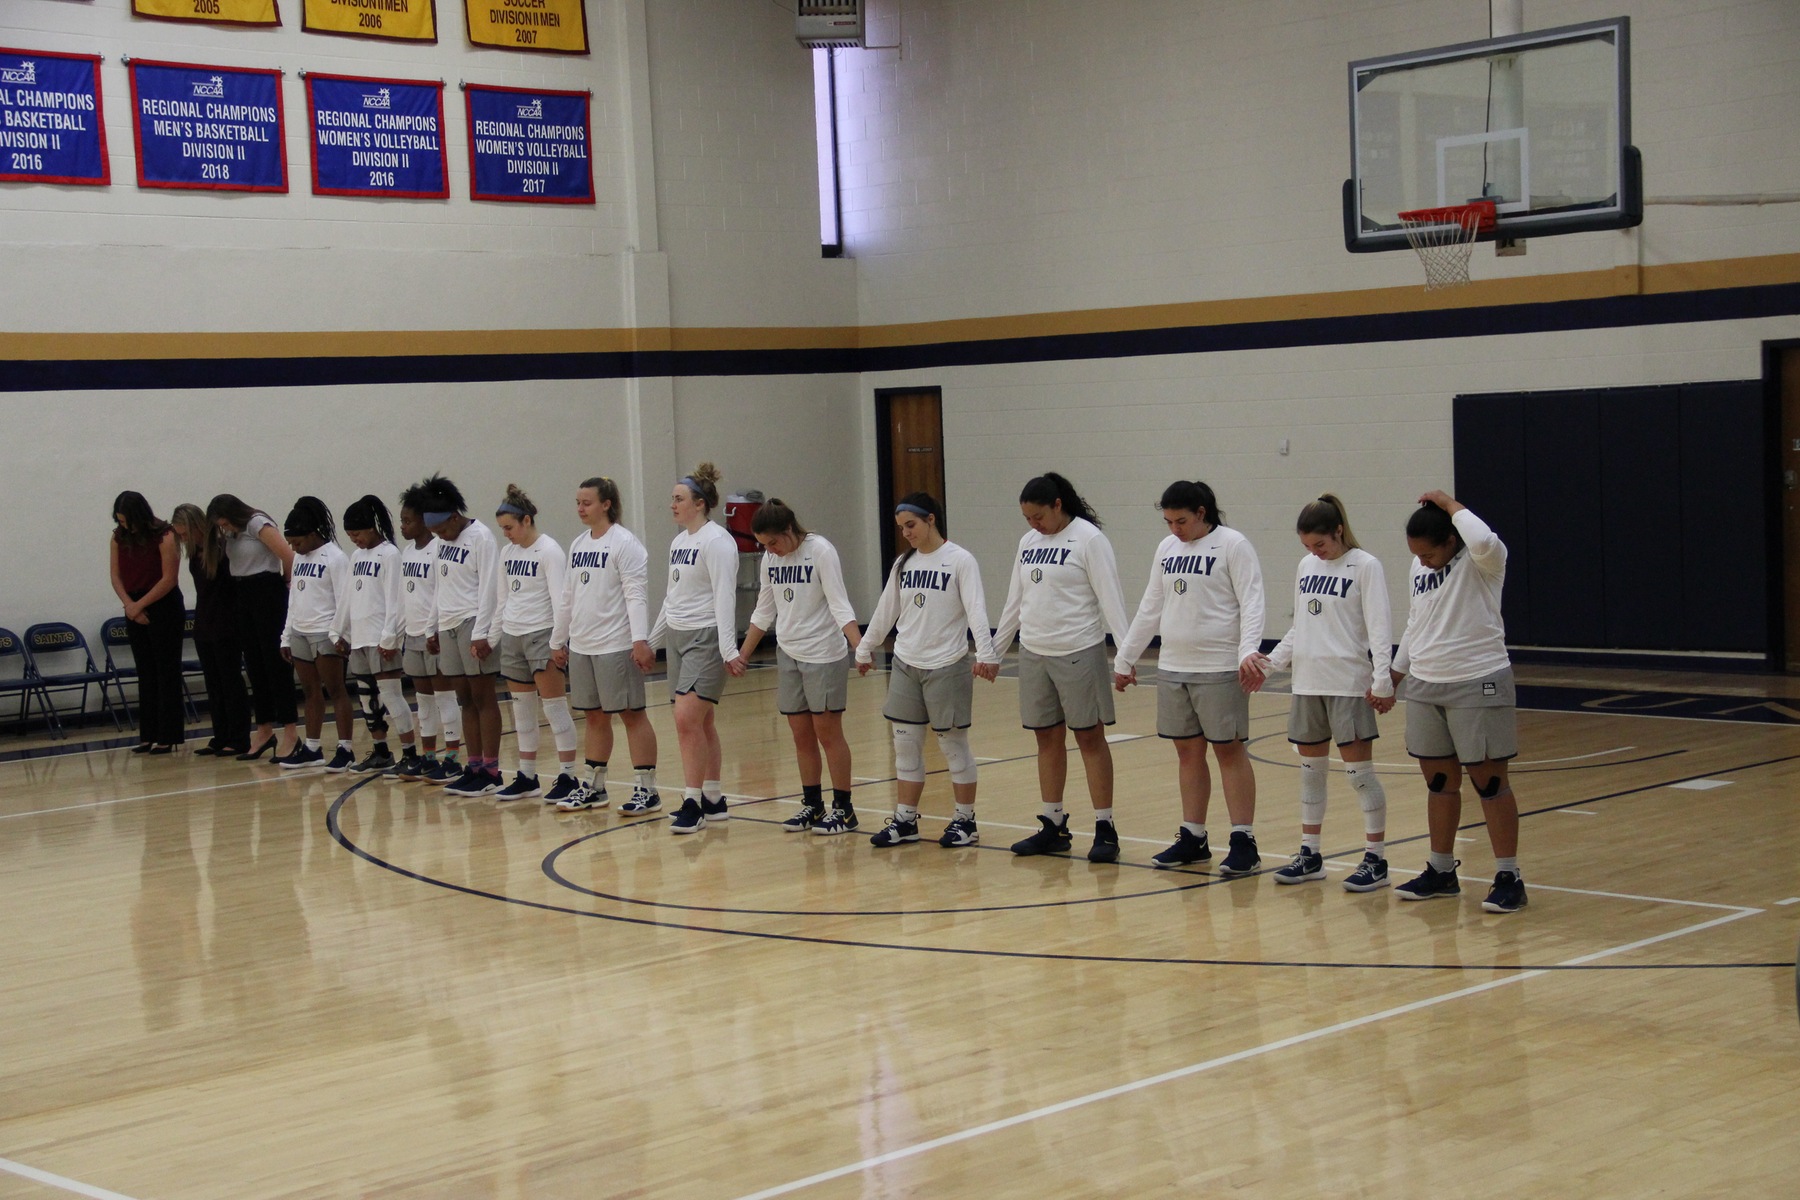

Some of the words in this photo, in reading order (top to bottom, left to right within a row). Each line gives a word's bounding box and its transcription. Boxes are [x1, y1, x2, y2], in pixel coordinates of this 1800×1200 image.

[193, 0, 220, 14] 2005
[331, 0, 378, 9] ISION
[385, 0, 408, 12] MEN
[359, 12, 382, 28] 2006
[489, 9, 532, 25] DIVISION
[533, 12, 539, 26] II
[540, 12, 560, 27] MEN
[515, 28, 537, 44] 2007
[2, 71, 36, 81] NCCAA
[193, 85, 224, 95] NCCAA
[16, 89, 95, 111] CHAMPIONS
[363, 97, 391, 107] NCCAA
[142, 98, 203, 119] REGIONAL
[206, 103, 276, 123] CHAMPIONS
[4, 109, 86, 131] BASKETBALL
[317, 110, 372, 128] REGIONAL
[374, 113, 437, 132] CHAMPIONS
[153, 120, 193, 138] MEN'S
[195, 122, 270, 142] BASKETBALL
[318, 129, 371, 148] WOMEN'S
[373, 132, 439, 150] VOLLEYBALL
[475, 120, 526, 138] REGIONAL
[527, 123, 584, 141] CHAMPIONS
[0, 131, 48, 149] IVISION
[51, 134, 61, 150] II
[475, 139, 525, 157] WOMEN'S
[526, 142, 587, 158] VOLLEYBALL
[182, 142, 234, 160] DIVISION
[237, 145, 246, 160] II
[352, 151, 399, 168] DIVISION
[402, 153, 409, 168] II
[11, 152, 43, 170] 2016
[507, 159, 550, 175] DIVISION
[552, 161, 559, 176] II
[201, 163, 230, 180] 2018
[369, 171, 395, 187] 2016
[522, 178, 546, 193] 2017
[571, 551, 609, 569] FAMILY
[1020, 547, 1071, 566] FAMILY
[1161, 555, 1217, 576] FAMILY
[293, 562, 327, 578] AMILY
[353, 561, 381, 577] AMILY
[402, 562, 430, 579] AMILY
[768, 565, 814, 584] FAMILY
[900, 570, 951, 591] FAMILY
[1299, 575, 1354, 598] FAMILY
[34, 631, 75, 645] SAINTS
